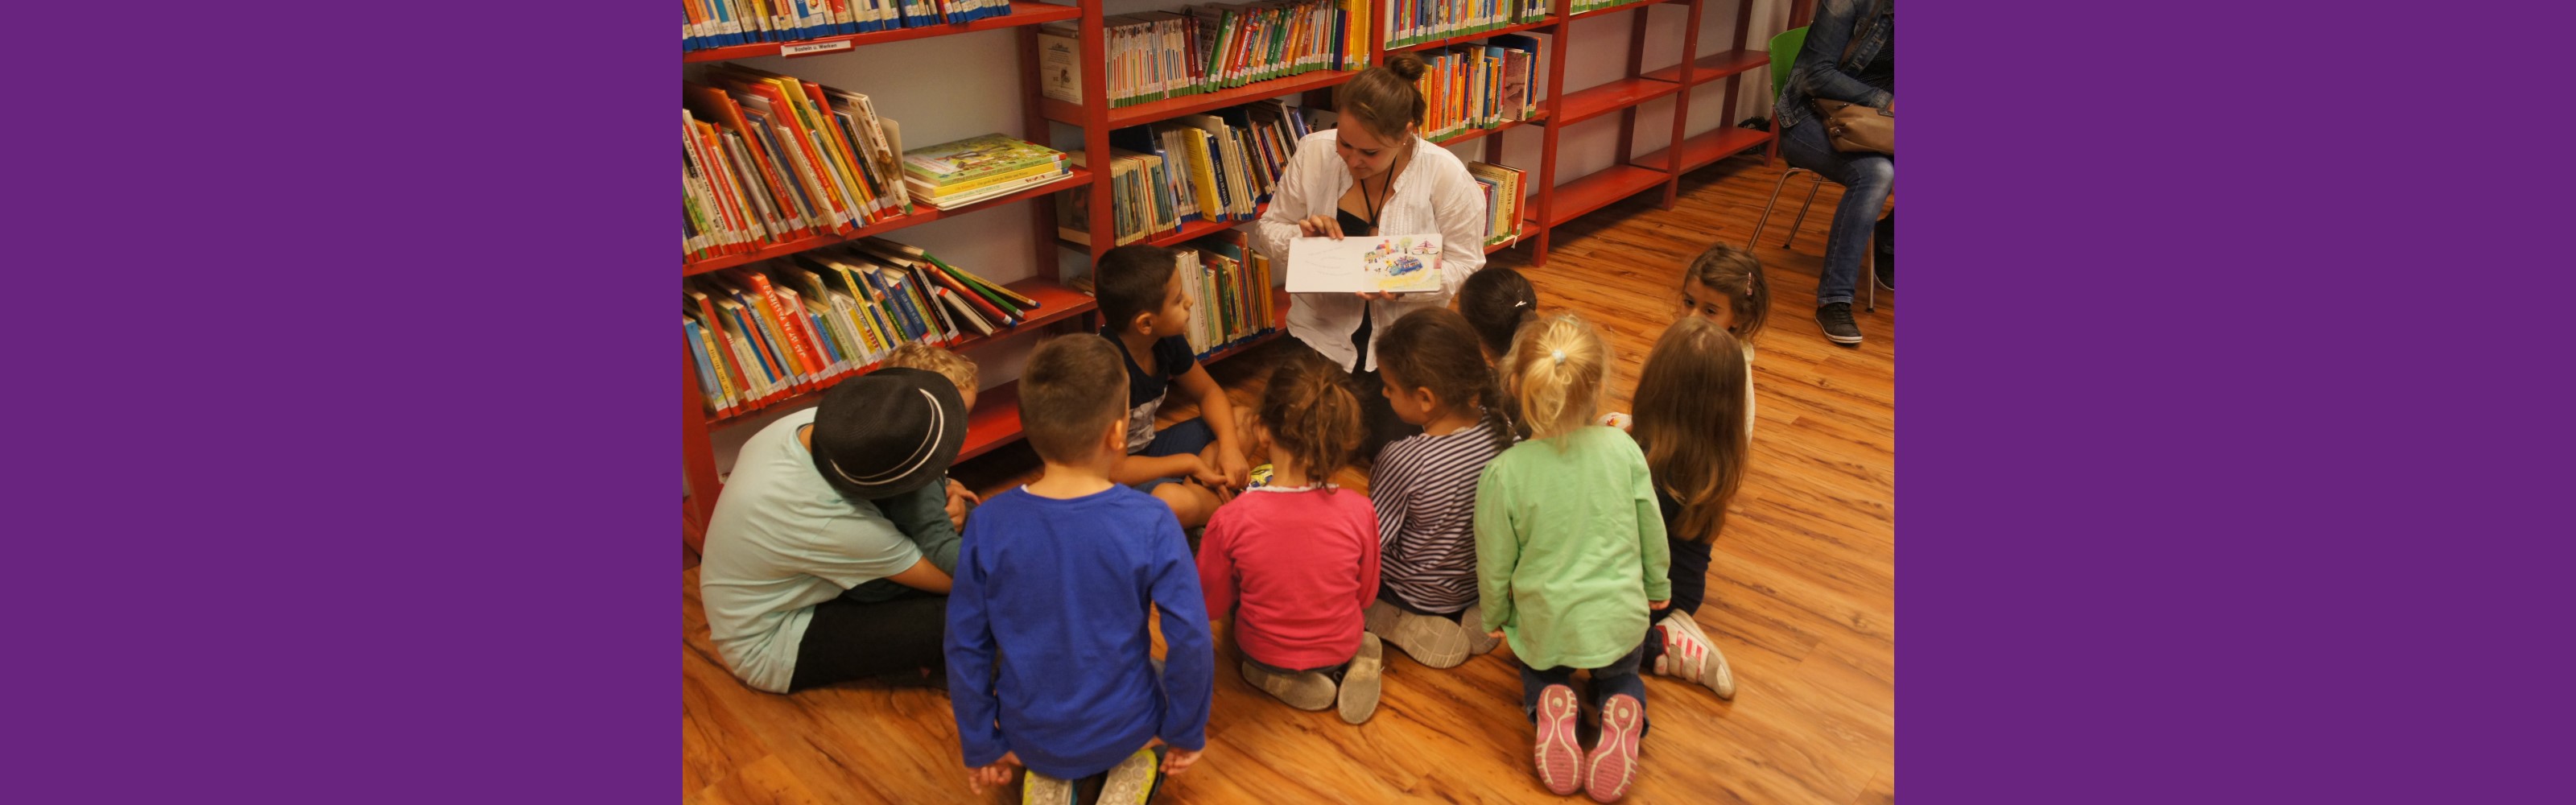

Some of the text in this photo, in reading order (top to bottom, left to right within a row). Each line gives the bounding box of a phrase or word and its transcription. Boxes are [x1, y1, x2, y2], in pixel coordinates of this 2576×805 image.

[782, 320, 793, 331] DA
[788, 331, 799, 343] IST
[795, 343, 807, 359] WAS
